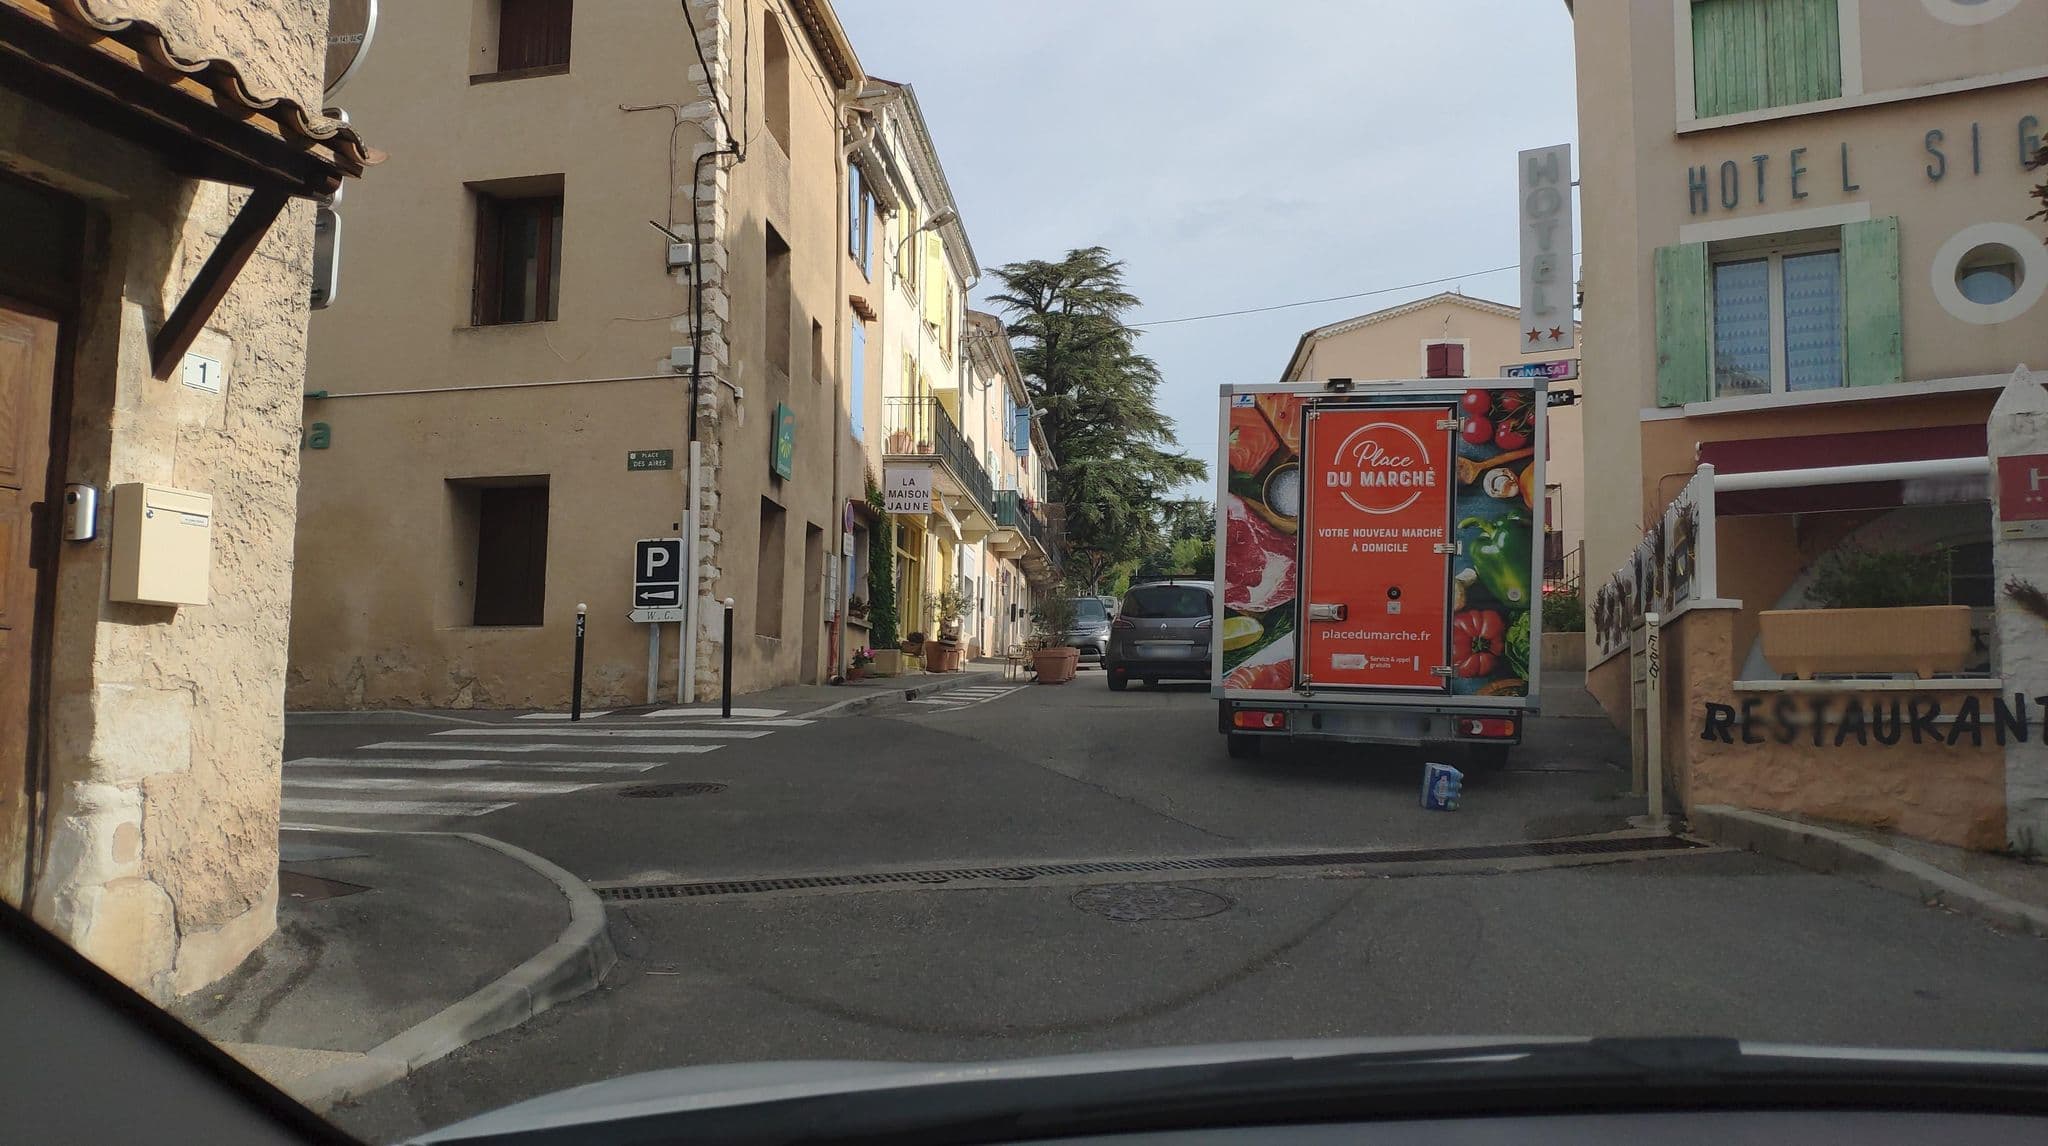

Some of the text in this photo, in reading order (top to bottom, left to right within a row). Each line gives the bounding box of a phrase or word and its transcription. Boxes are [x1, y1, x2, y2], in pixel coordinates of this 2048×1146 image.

[1688, 142, 1860, 215] HOTEL
[1525, 151, 1563, 316] HOTEL
[199, 362, 207, 384] 1
[1509, 364, 1567, 377] CANALSAT
[1353, 440, 1414, 468] Place
[648, 459, 667, 467] AIRES
[902, 477, 915, 486] LA
[1326, 466, 1436, 488] DU MARCHÉ
[888, 489, 929, 499] MAISON
[887, 502, 929, 511] JAUNE
[1319, 525, 1443, 538] VOTRE NOUVEAU MARCHÉ
[1362, 543, 1408, 553] DOMICILE
[646, 547, 670, 577] P
[1322, 628, 1431, 641] placedumarche.fr
[1369, 655, 1390, 663] Service
